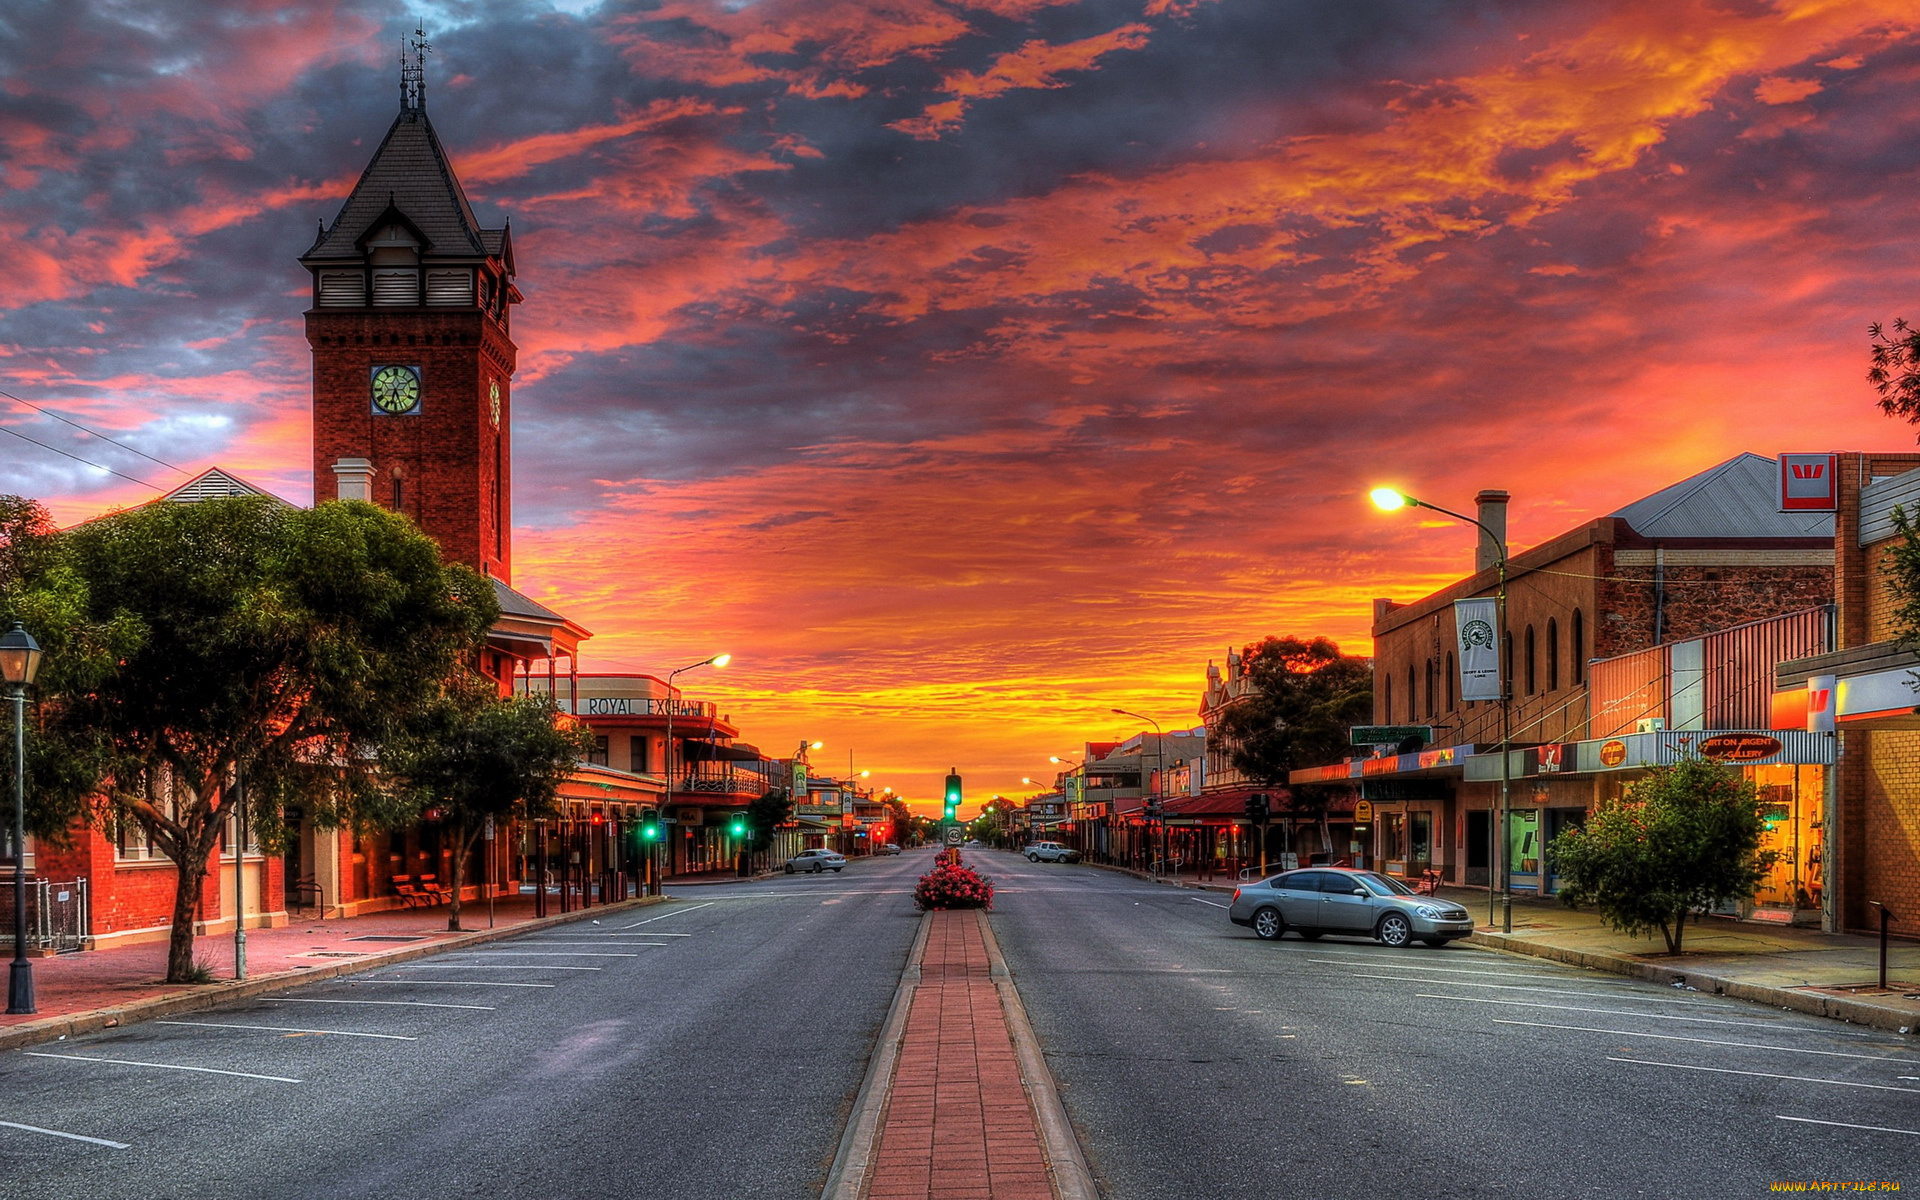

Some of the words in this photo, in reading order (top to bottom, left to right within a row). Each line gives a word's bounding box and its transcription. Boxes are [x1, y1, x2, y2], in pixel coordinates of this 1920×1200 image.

[589, 699, 636, 715] ROYAL
[1704, 739, 1721, 752] ART
[1738, 738, 1773, 752] ARGENT
[1727, 750, 1763, 758] GALLERY
